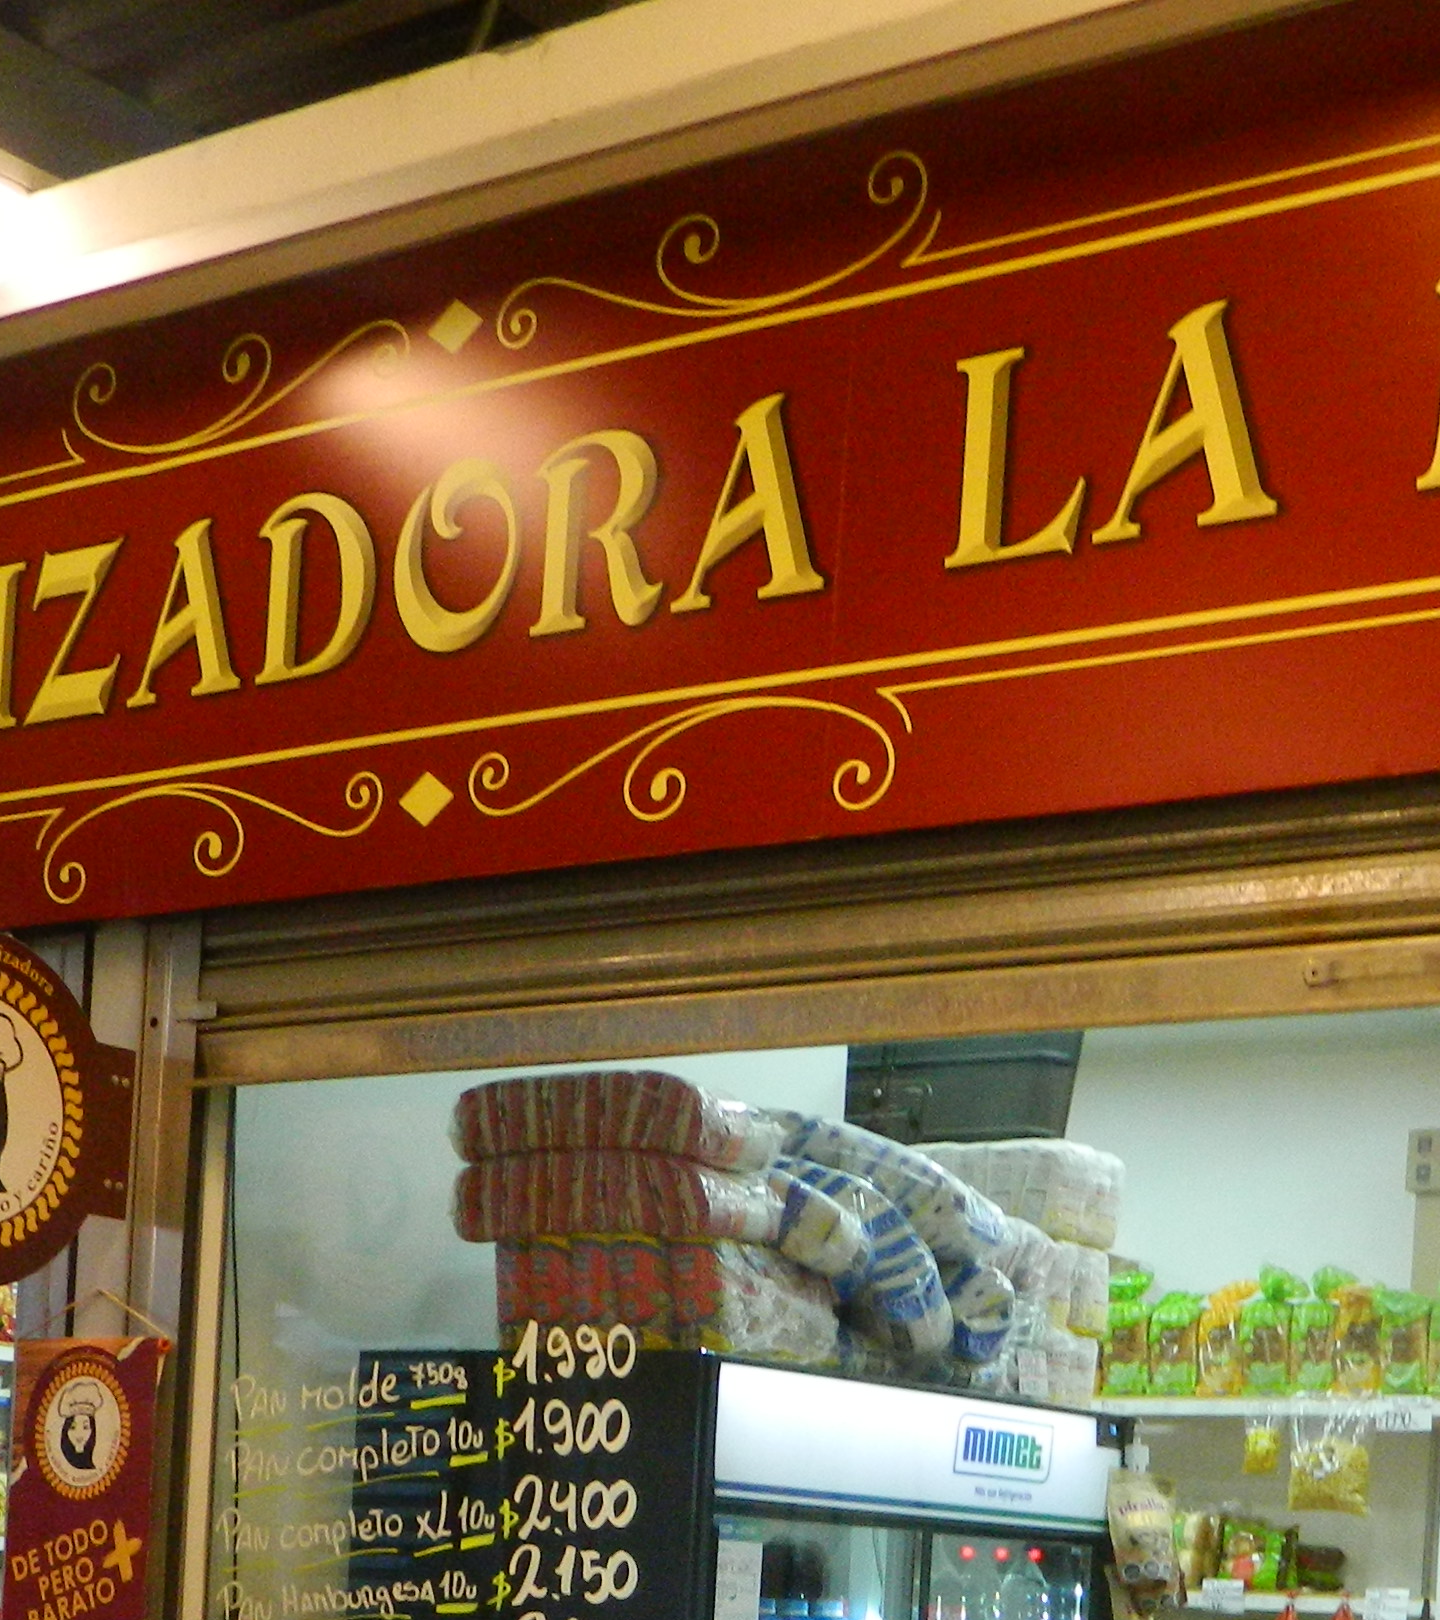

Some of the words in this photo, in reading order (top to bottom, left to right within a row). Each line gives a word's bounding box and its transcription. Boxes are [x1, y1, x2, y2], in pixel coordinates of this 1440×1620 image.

[943, 298, 1279, 571] LA
[13, 1190, 24, 1208] y
[26, 1120, 60, 1192] cariño
[11, 1548, 41, 1582] DE
[46, 1518, 108, 1567] TODO
[37, 1556, 95, 1601] PERO
